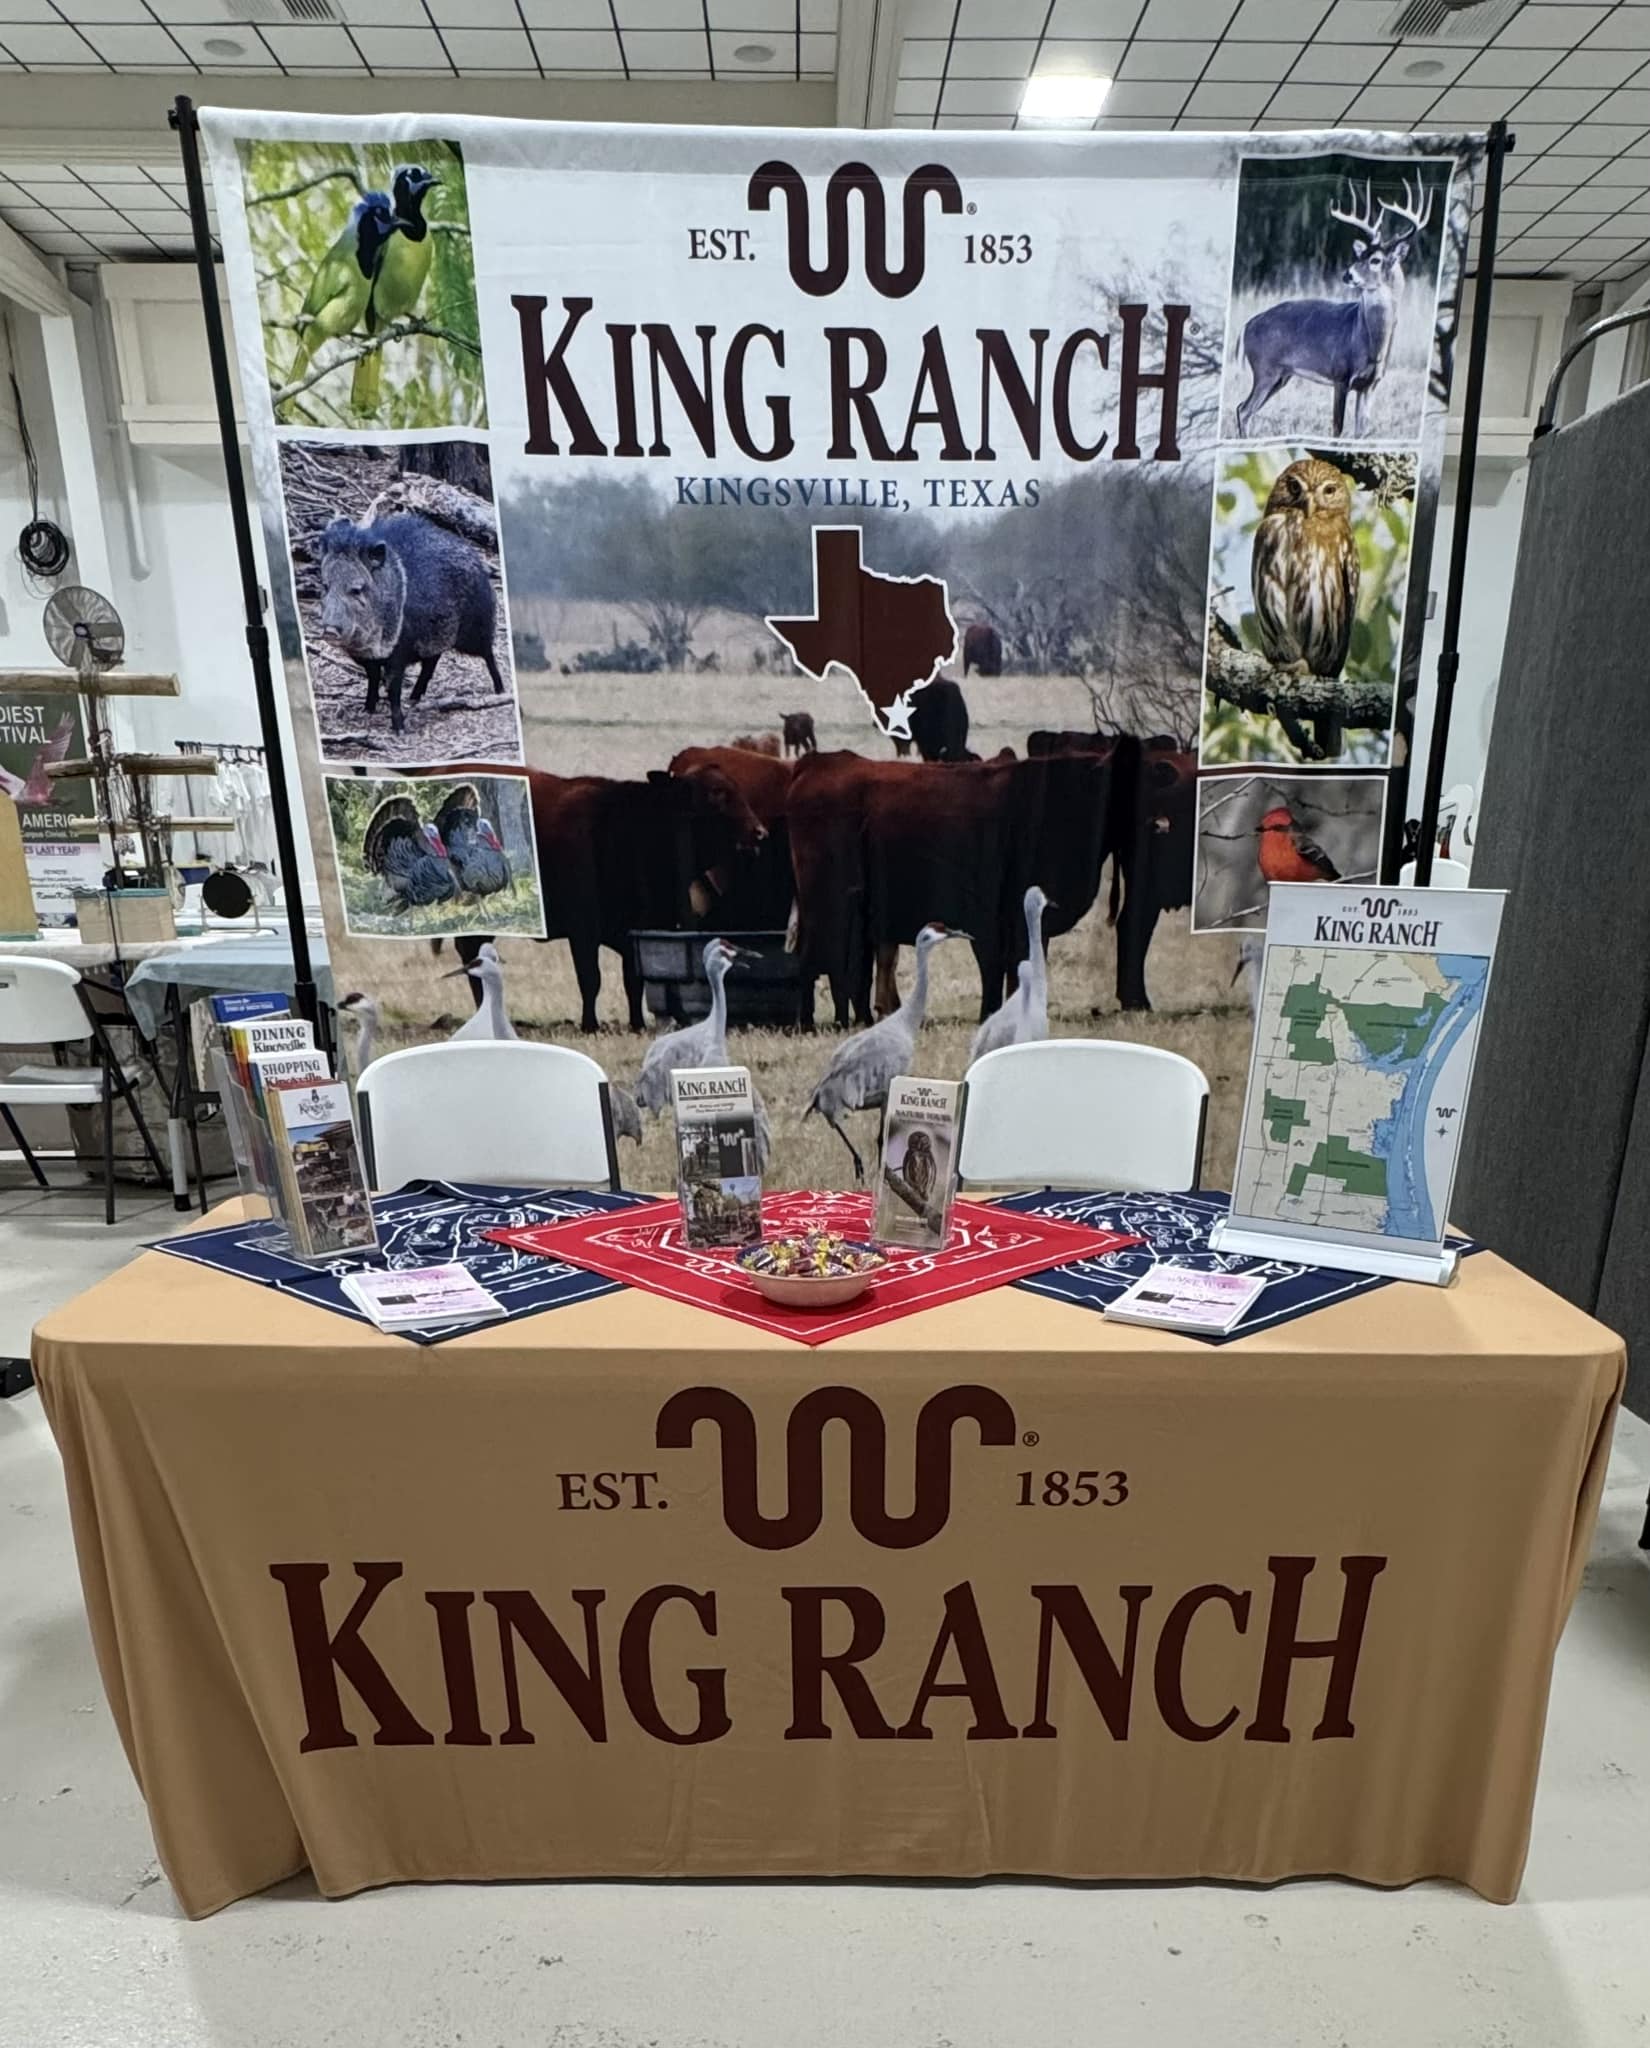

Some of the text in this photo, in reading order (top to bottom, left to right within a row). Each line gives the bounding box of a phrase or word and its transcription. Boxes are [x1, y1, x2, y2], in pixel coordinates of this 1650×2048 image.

[688, 228, 1032, 264] EST. 1853
[511, 295, 1192, 462] KING RANCH
[676, 476, 1041, 512] KINGSVILLE, TEXAS
[23, 813, 85, 828] AMERIC
[1368, 920, 1441, 947] RANCH
[251, 1026, 306, 1042] DINING
[262, 1060, 320, 1076] SHOPPING
[709, 1077, 747, 1094] RANCH
[556, 1469, 1130, 1511] EST. 1853
[269, 1555, 1387, 1754] KING RANCH
